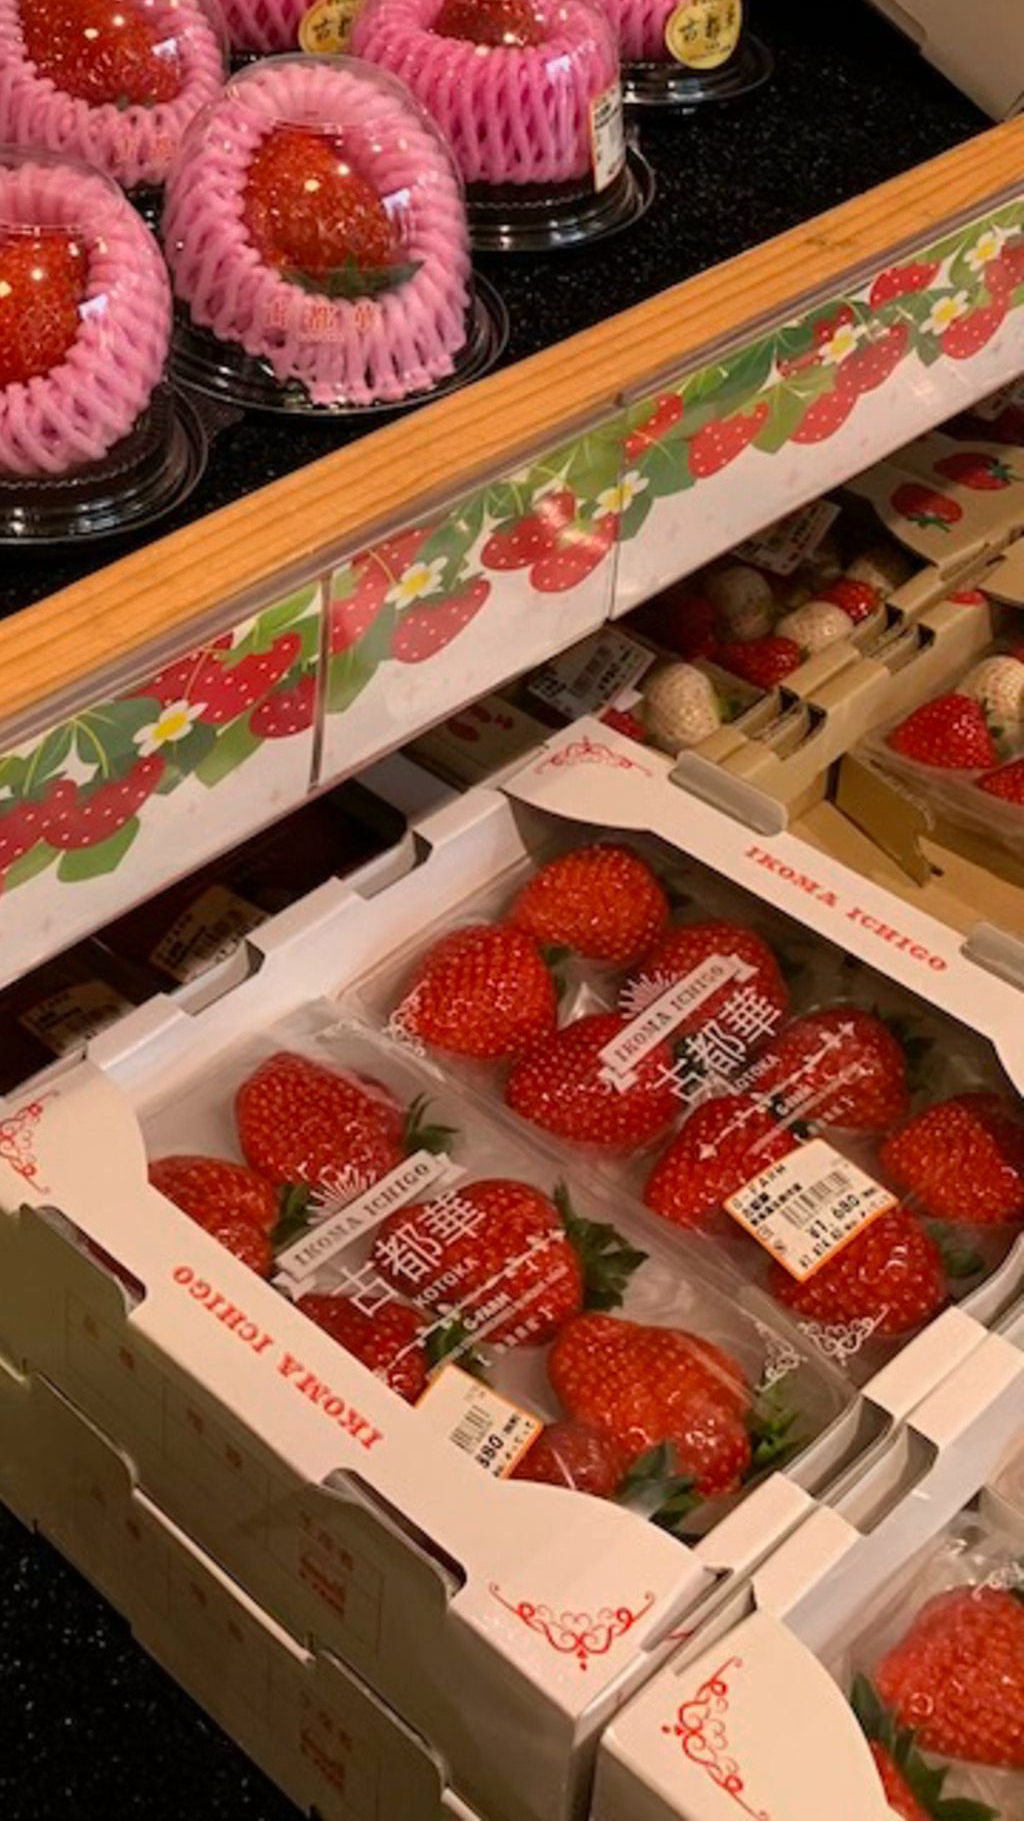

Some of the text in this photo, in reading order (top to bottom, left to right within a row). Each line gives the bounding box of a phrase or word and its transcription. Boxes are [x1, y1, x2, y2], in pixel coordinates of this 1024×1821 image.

[745, 846, 948, 972] IKOMA ICHIGO
[613, 963, 725, 1062] IKOMA ICHIGO
[652, 985, 782, 1104] 古都華
[294, 1162, 430, 1268] IKOMA ICHIGO
[331, 1189, 487, 1318] 古都華
[173, 1265, 275, 1355] ICHIGO
[412, 1256, 480, 1307] KOTOKA
[278, 1351, 384, 1450] IKOMA
